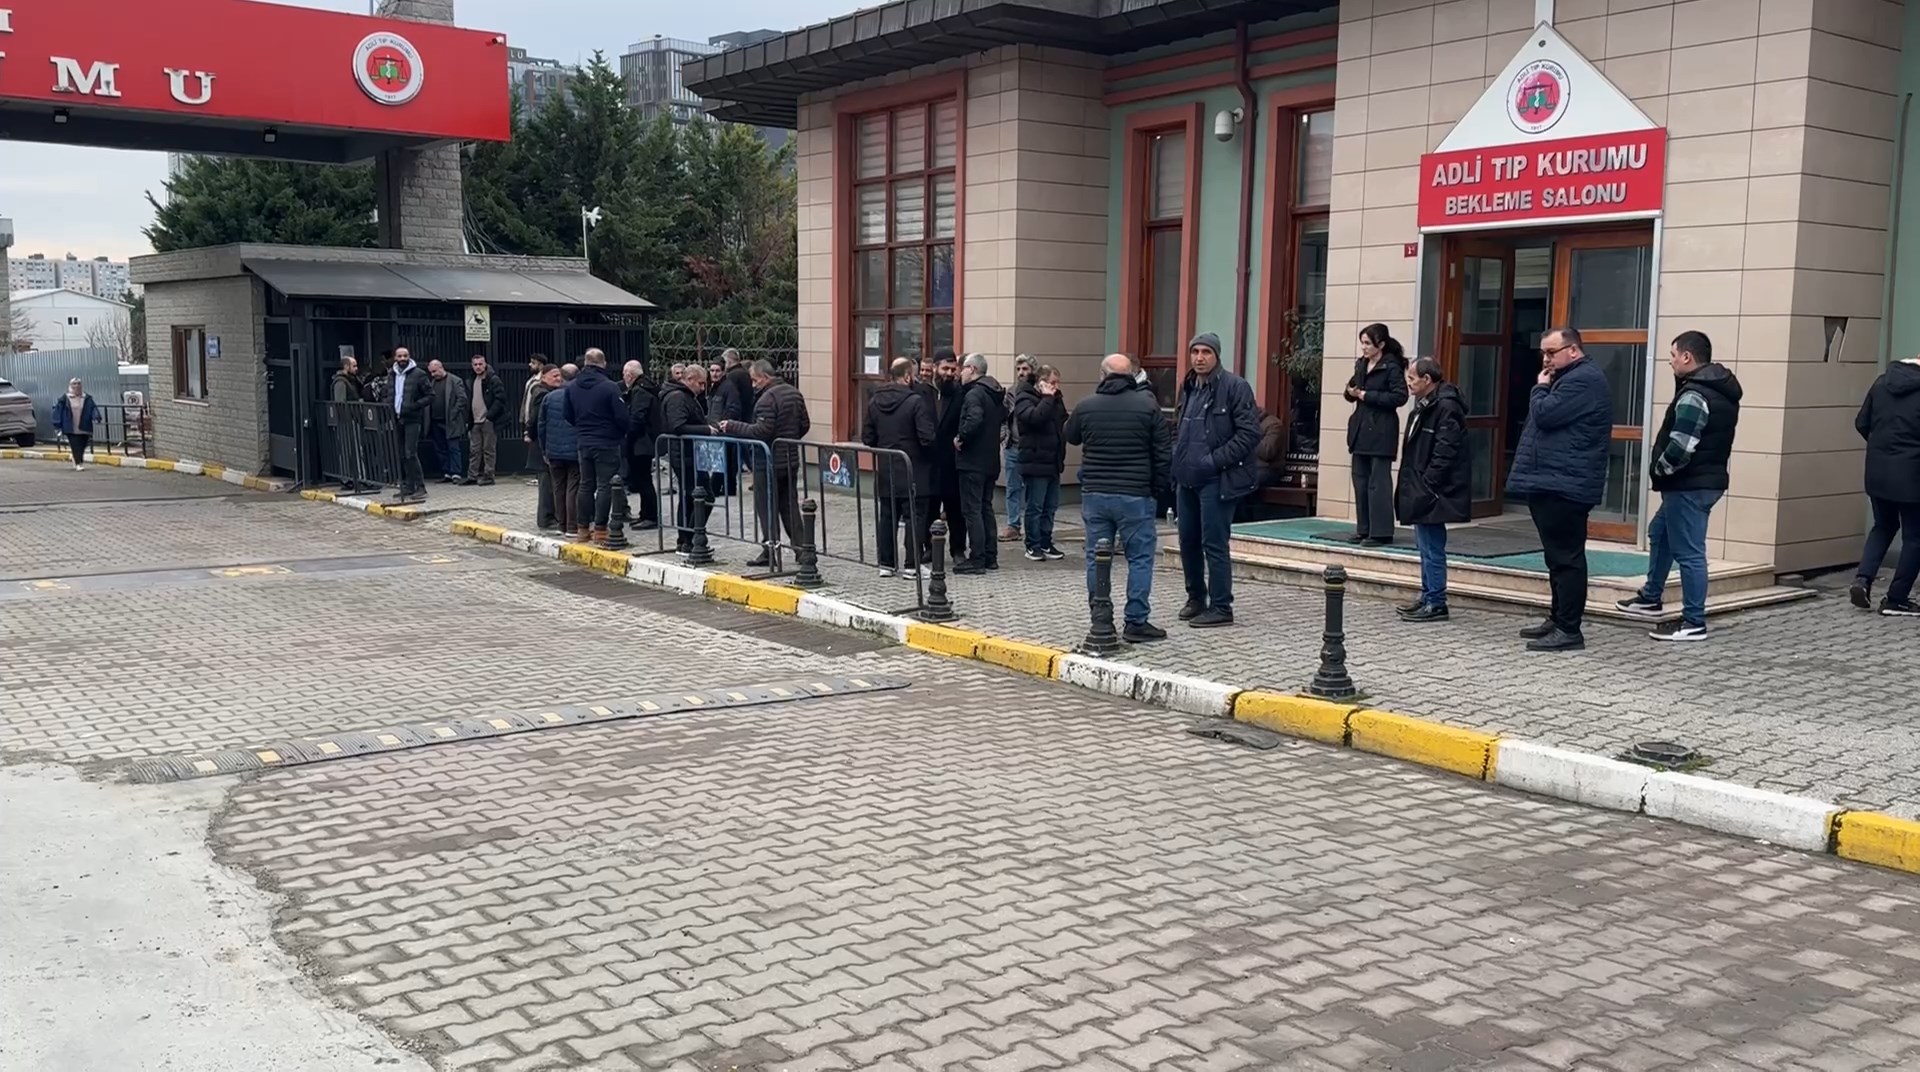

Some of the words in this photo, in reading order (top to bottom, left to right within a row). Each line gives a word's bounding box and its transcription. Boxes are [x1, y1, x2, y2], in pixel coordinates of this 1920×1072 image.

[0, 51, 217, 105] MU
[1431, 155, 1482, 187] ADLİ
[1491, 154, 1528, 181] TIP
[1537, 143, 1648, 177] KURUMU
[1445, 190, 1533, 216] BEKLEME
[1542, 182, 1627, 208] SALONU
